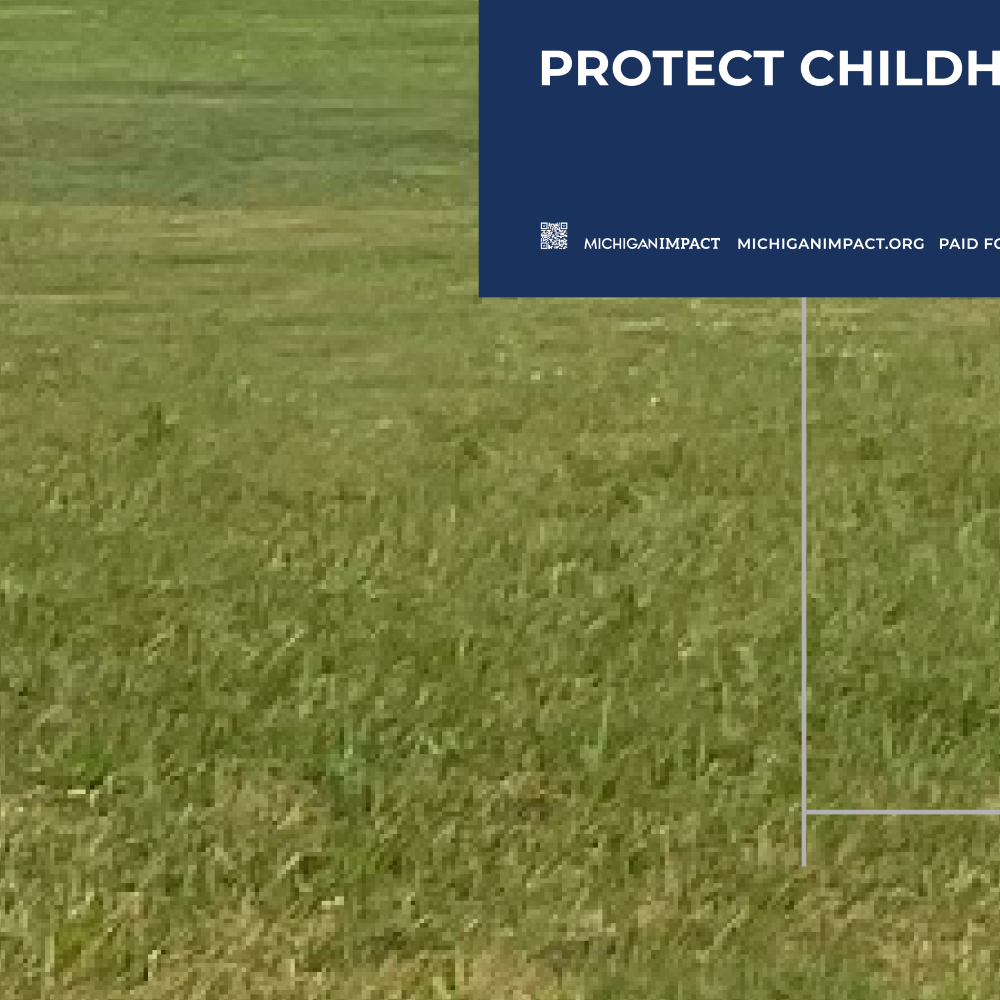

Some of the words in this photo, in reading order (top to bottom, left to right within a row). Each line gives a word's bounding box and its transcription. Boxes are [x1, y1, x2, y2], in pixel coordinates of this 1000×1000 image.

[541, 50, 784, 86] PROTECT
[737, 237, 925, 250] MICHIGANIMPACT.ORG
[939, 237, 978, 250] PAID
